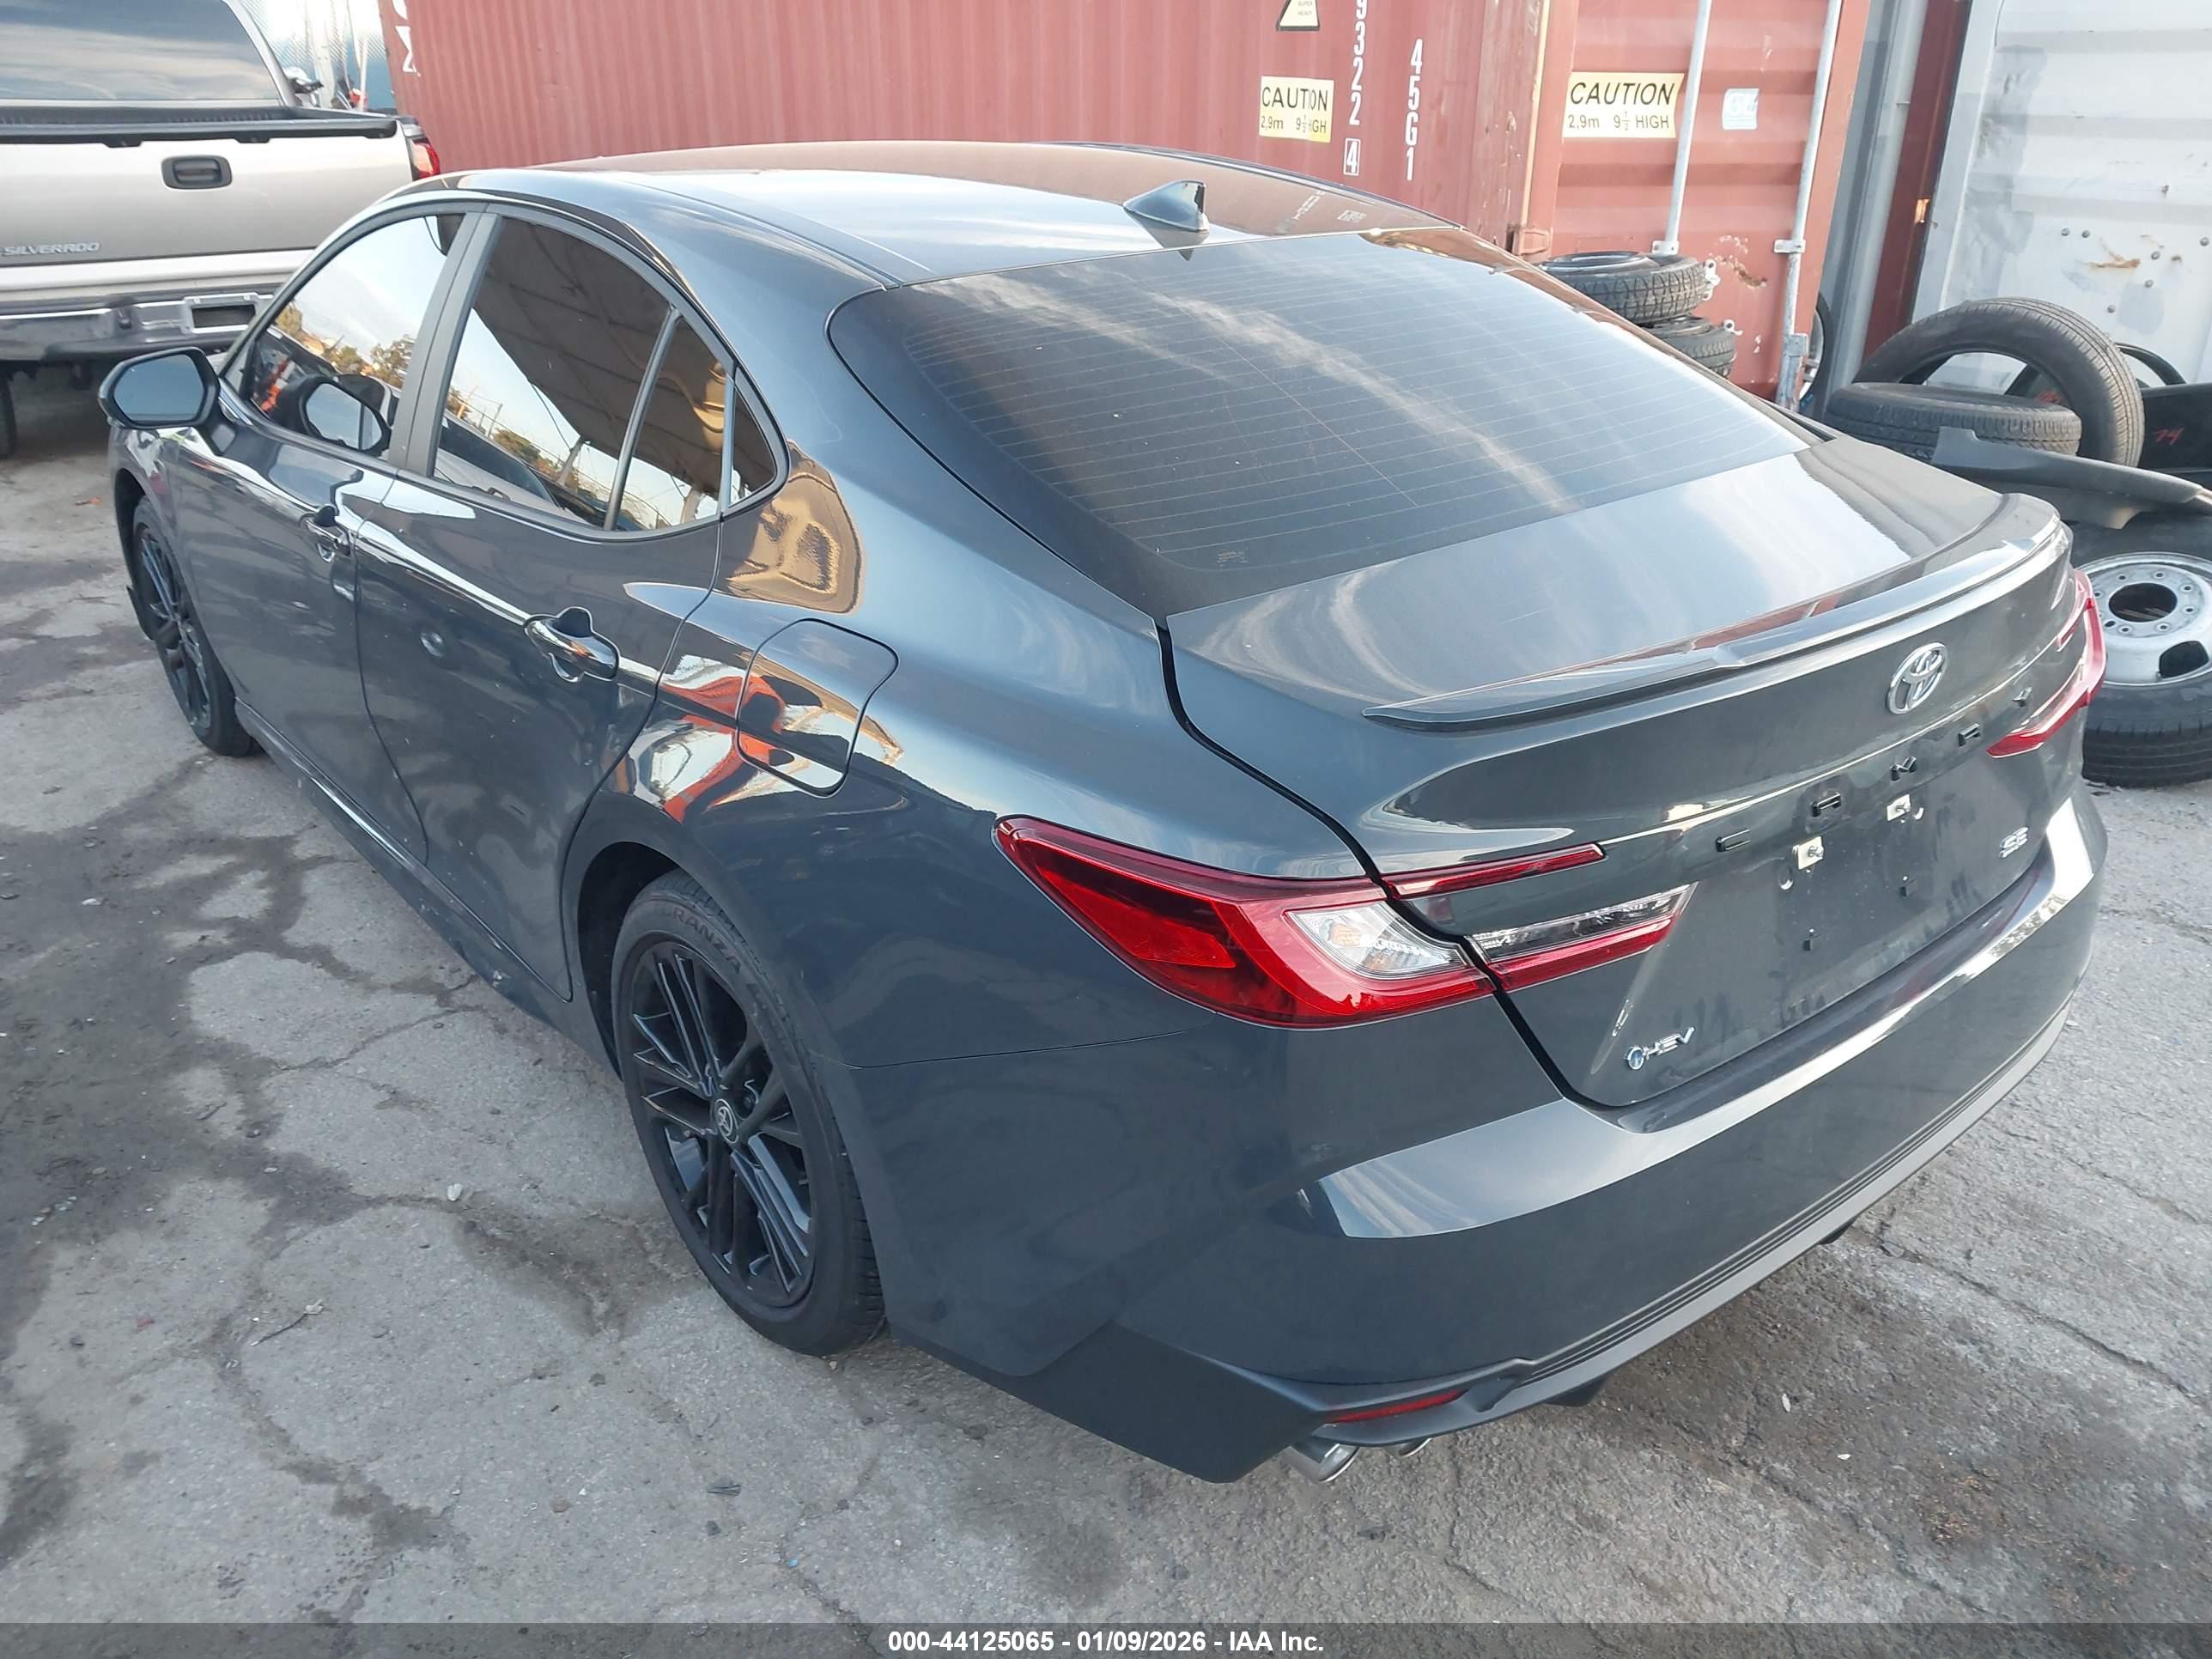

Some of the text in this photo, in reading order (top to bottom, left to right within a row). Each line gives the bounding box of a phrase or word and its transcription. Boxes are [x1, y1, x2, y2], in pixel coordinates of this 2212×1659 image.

[1571, 82, 1675, 106] CAUTION
[1406, 39, 1423, 180] 45G1
[1568, 114, 1600, 129] 2,9m
[1636, 115, 1669, 130] HIGH
[2, 242, 100, 257] SILVERADO
[1999, 826, 2028, 859] SE
